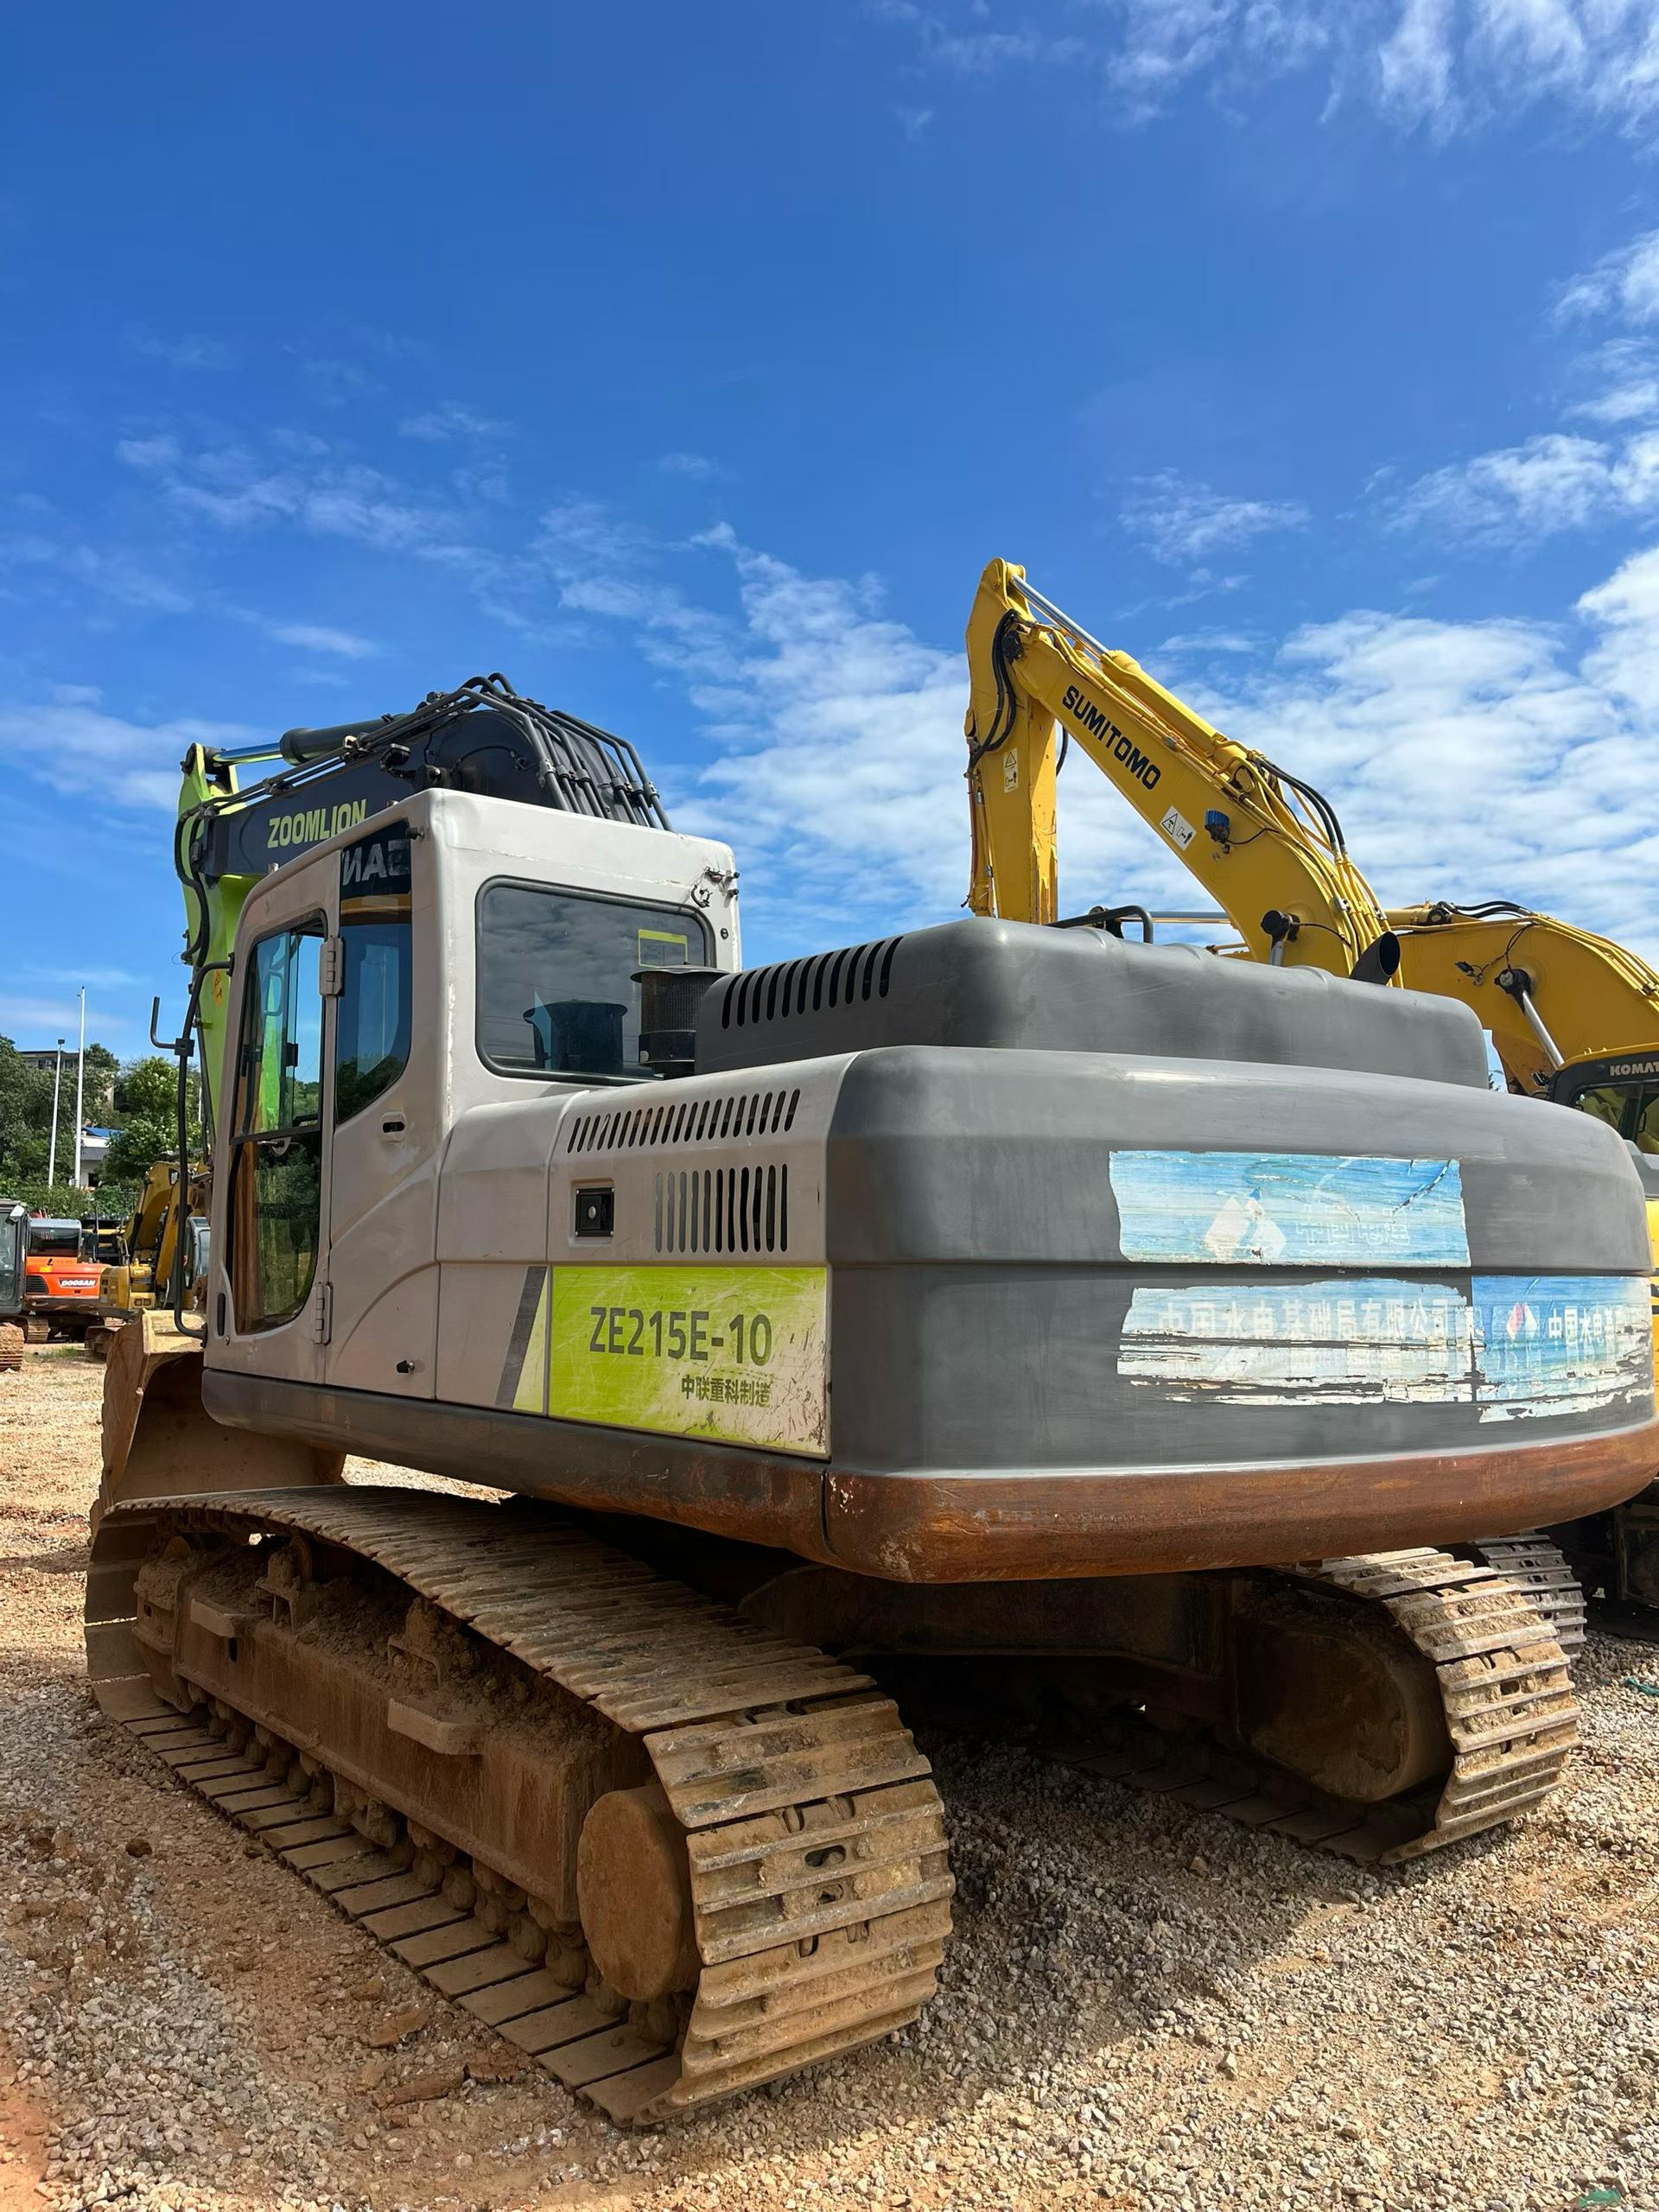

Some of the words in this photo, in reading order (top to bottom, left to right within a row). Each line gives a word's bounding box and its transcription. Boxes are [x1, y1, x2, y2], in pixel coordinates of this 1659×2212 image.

[1062, 685, 1161, 790] SUMITOMO
[267, 798, 367, 849] ZOOMLION
[589, 1306, 772, 1366] ZE215E-10
[681, 1374, 773, 1408] 中联重科制造
